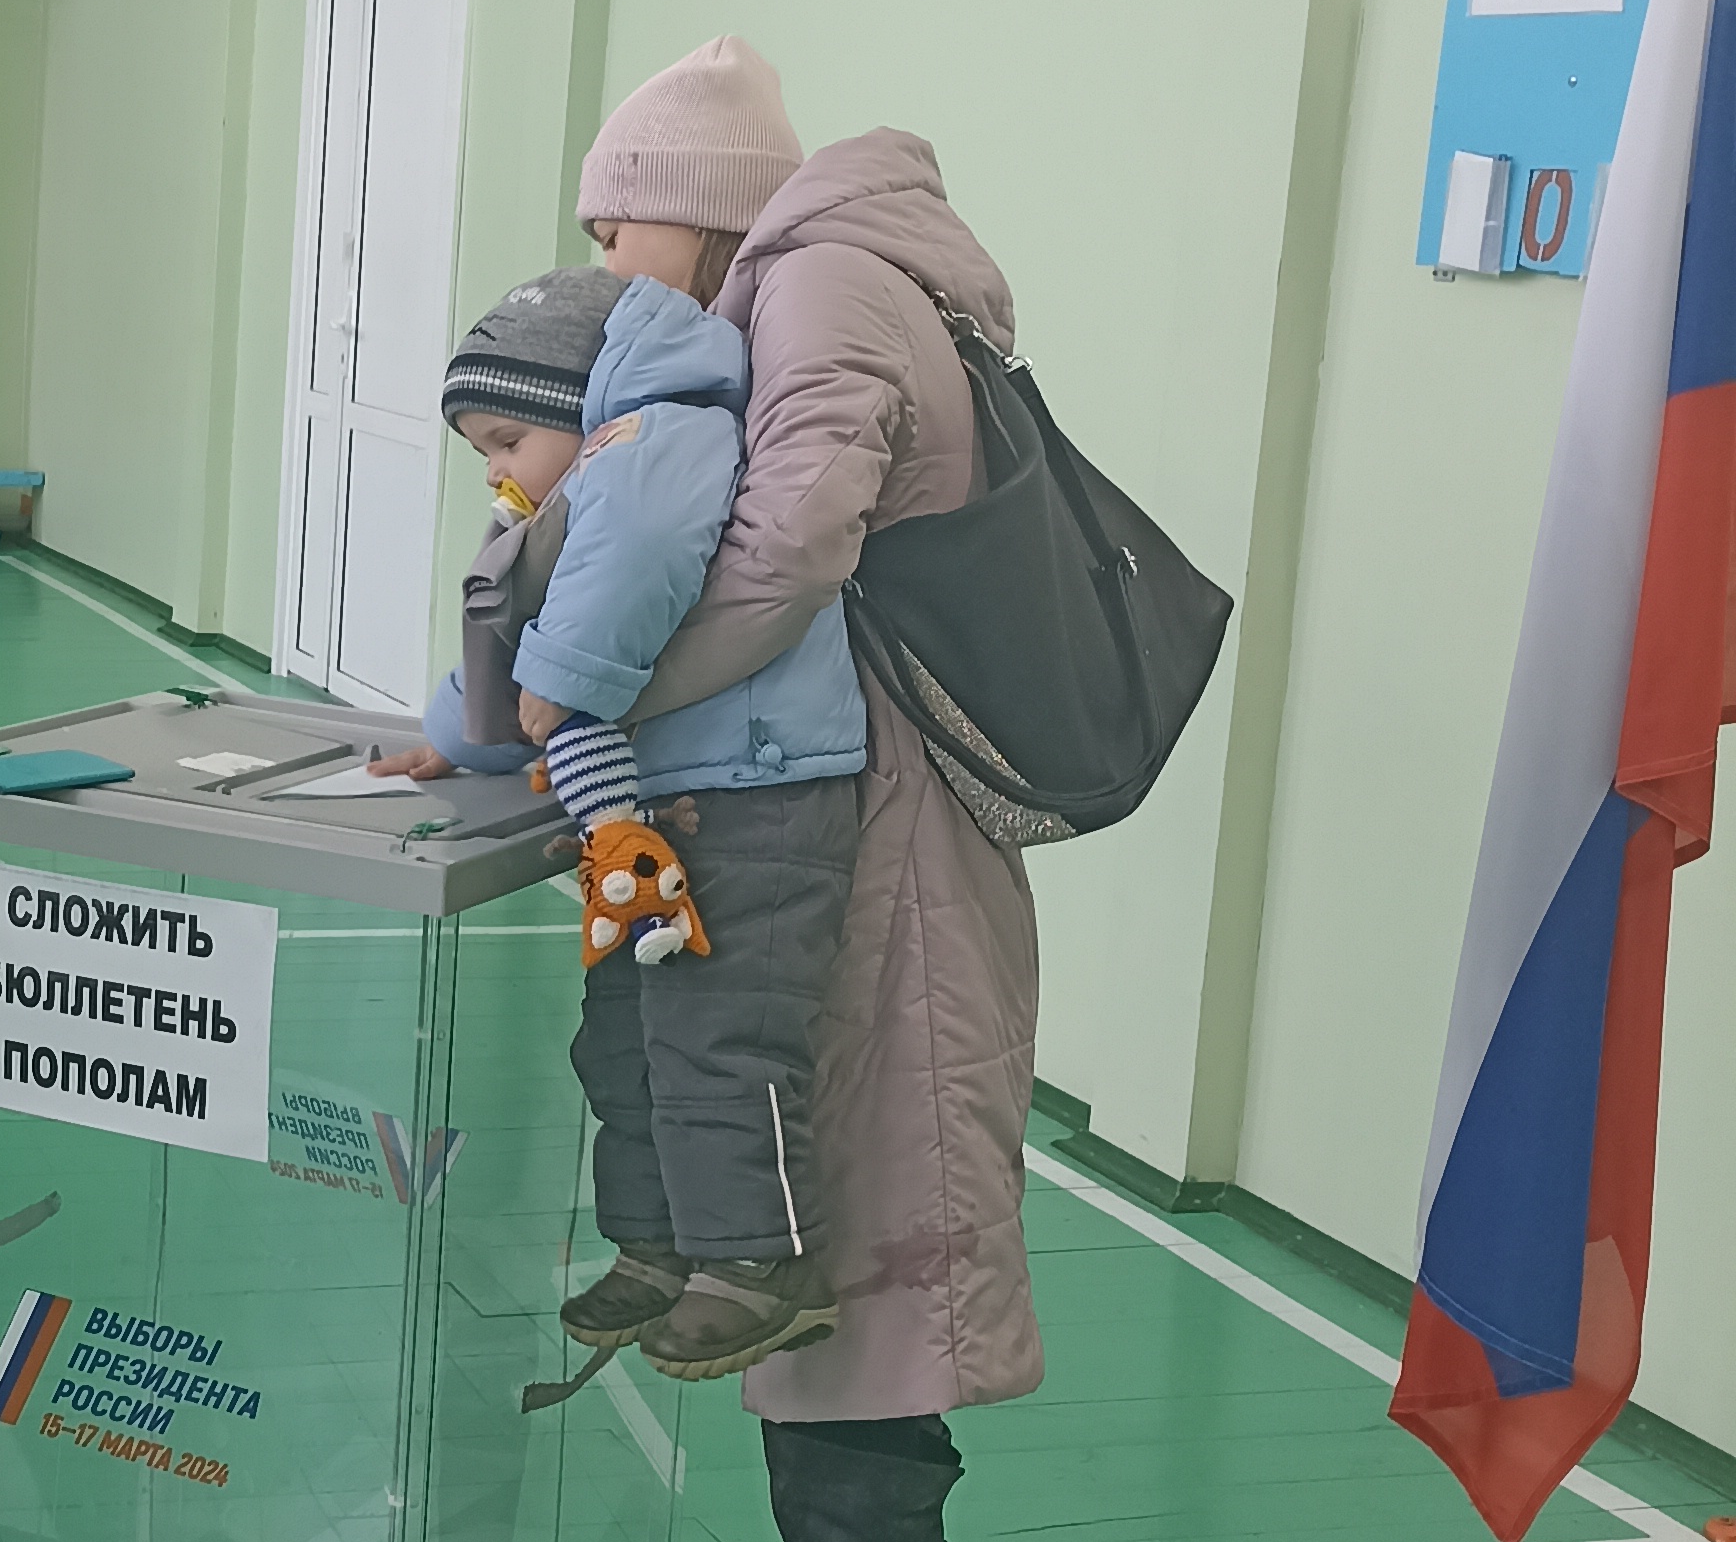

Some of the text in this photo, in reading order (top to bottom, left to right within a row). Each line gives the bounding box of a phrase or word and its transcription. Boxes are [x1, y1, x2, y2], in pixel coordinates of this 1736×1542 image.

[7, 885, 214, 958] СЛОЖИТЬ
[3, 1039, 208, 1120] ПОПОЛАМ
[84, 1306, 223, 1366] ВЫБОРЫ
[51, 1378, 176, 1435] РОССИИ
[67, 1342, 262, 1420] ПРЕЗИДЕНТА
[97, 1429, 173, 1472] МАРТА
[173, 1452, 230, 1488] 2024
